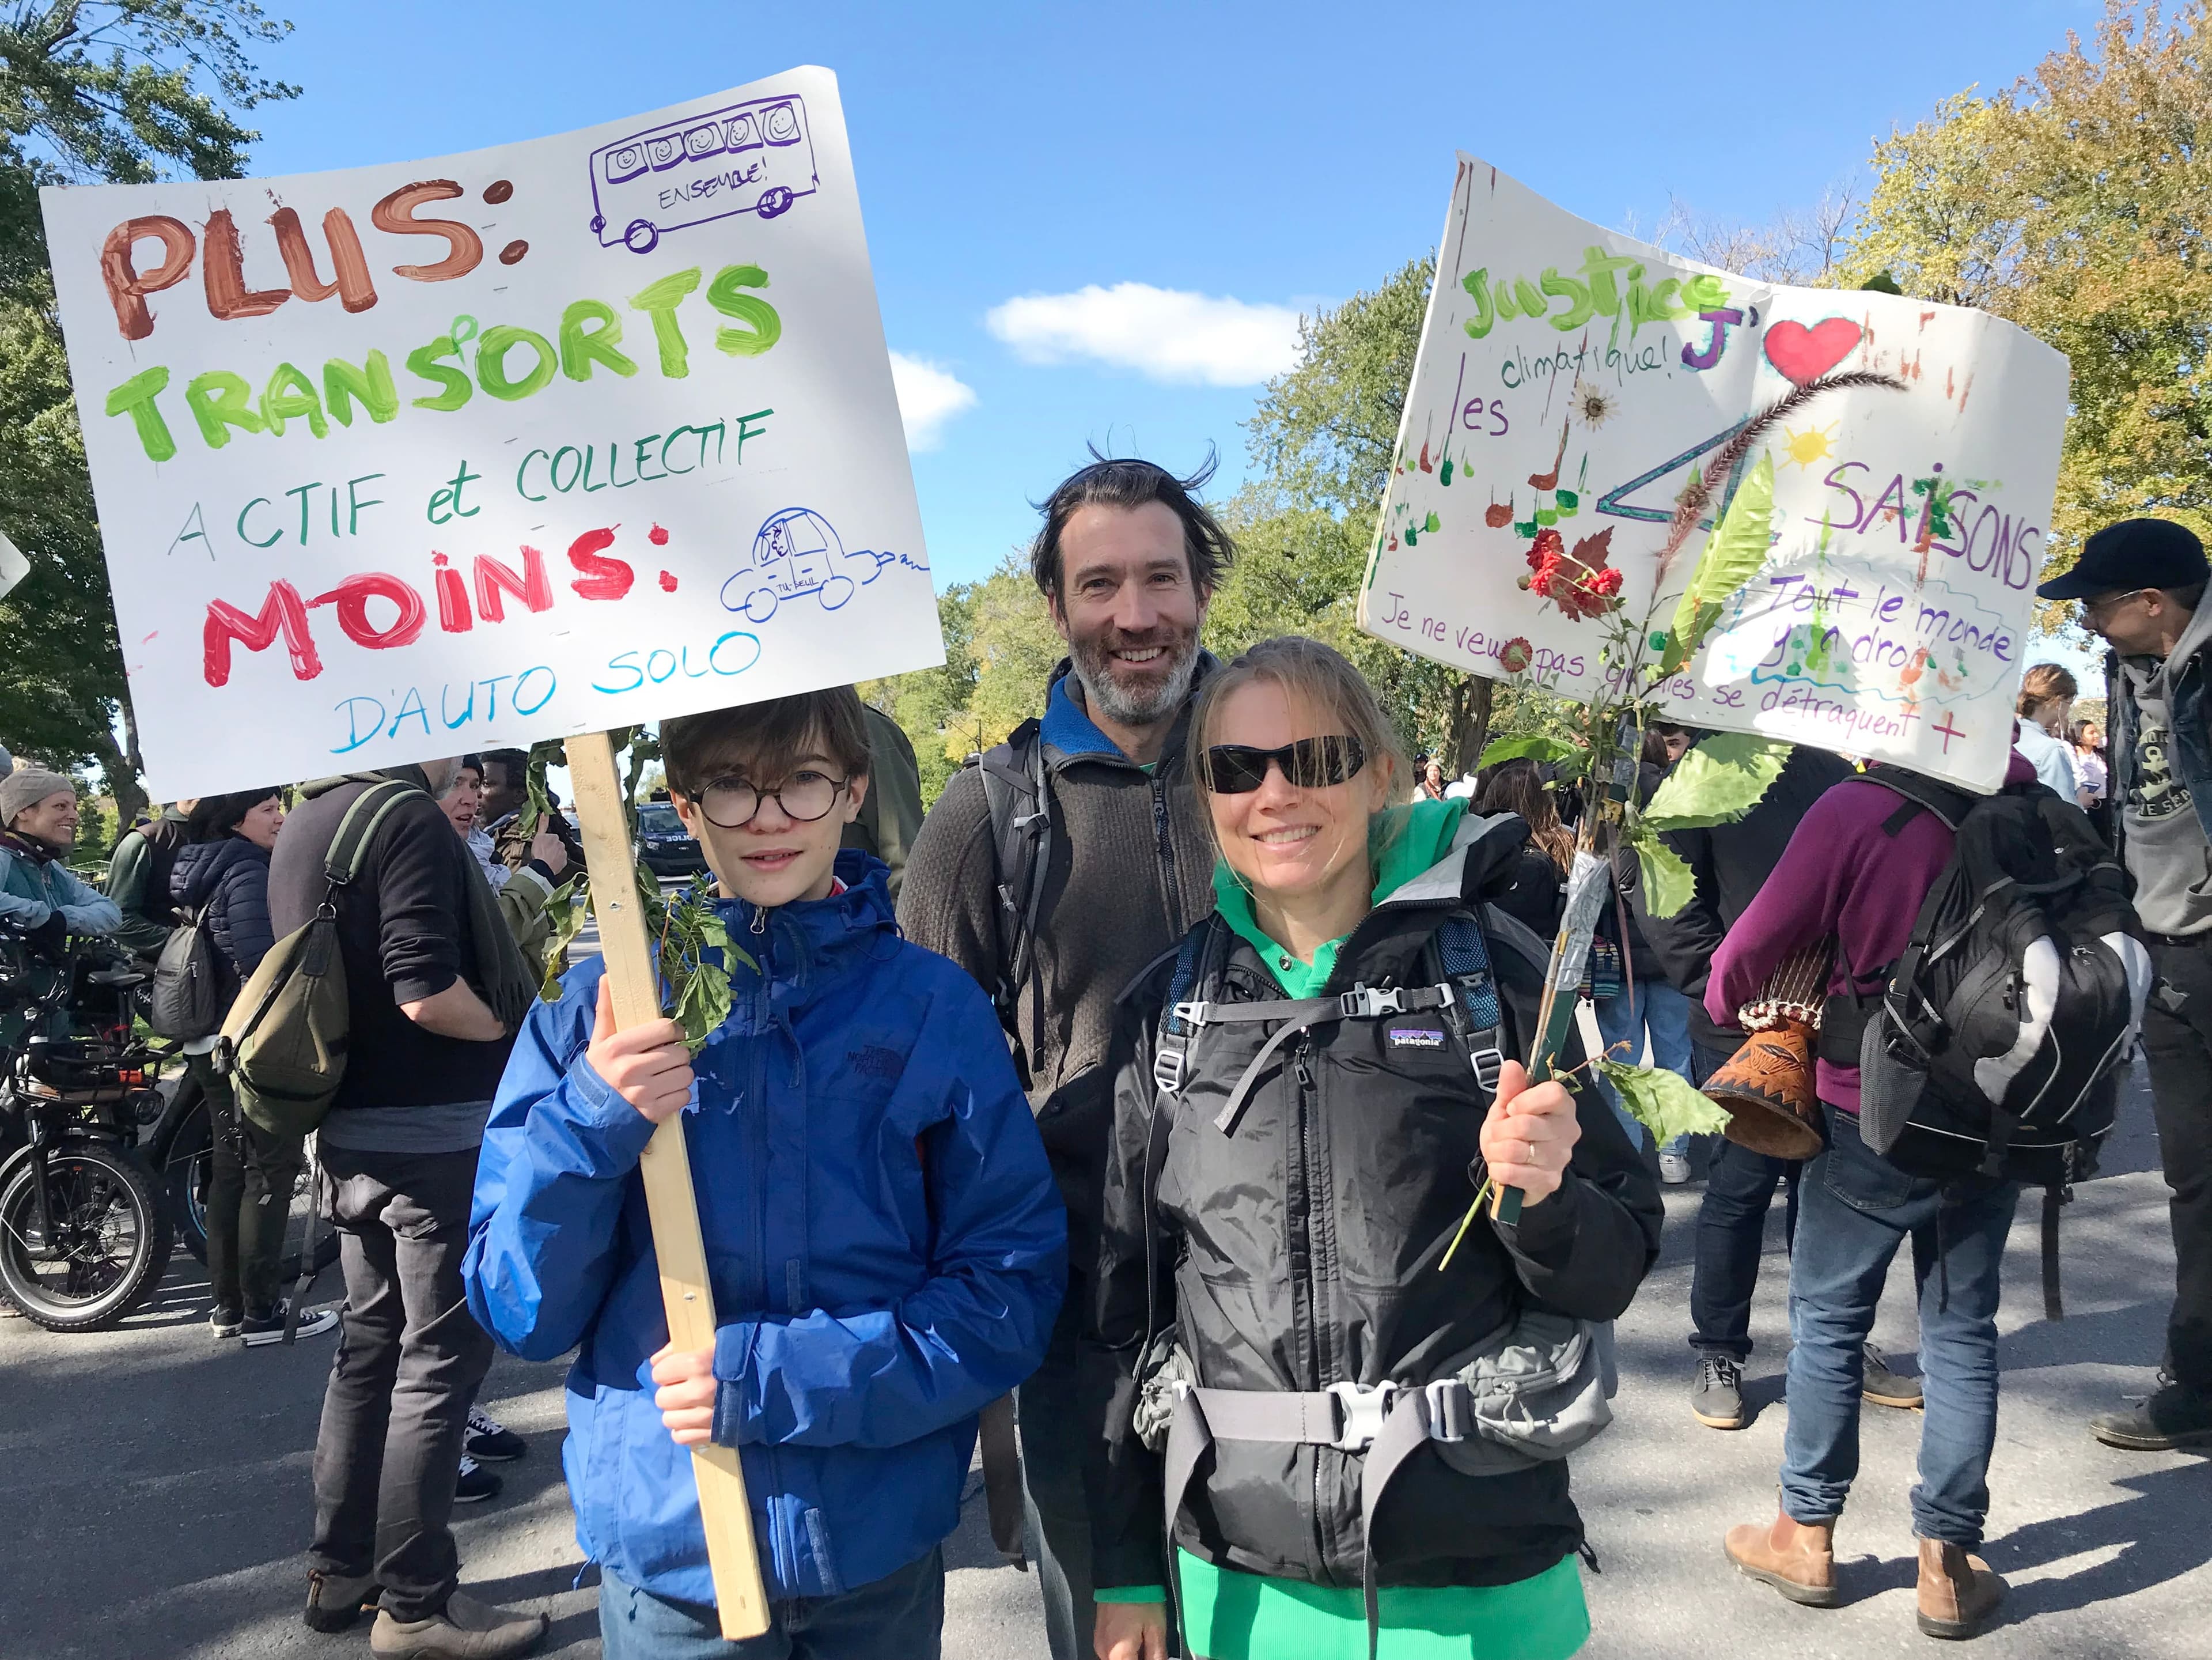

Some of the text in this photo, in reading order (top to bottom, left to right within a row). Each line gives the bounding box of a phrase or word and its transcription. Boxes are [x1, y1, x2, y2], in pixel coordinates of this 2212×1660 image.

[658, 156, 768, 209] ENSEMBLE!
[101, 179, 529, 341] PLUS:
[1449, 352, 1508, 436] les
[1501, 336, 1672, 388] climatique!
[168, 409, 774, 561] ACTIF et COLLECTIF
[1382, 592, 1411, 629] Je
[1422, 618, 1446, 641] ne
[1456, 626, 1508, 659] veu
[1536, 648, 1585, 682] pas
[1711, 684, 1745, 708] se
[1756, 623, 1792, 667] y
[1871, 585, 1904, 622] le
[1915, 601, 2012, 662] monde
[591, 632, 761, 694] SOLO
[1395, 1038, 1440, 1046] patagonia
